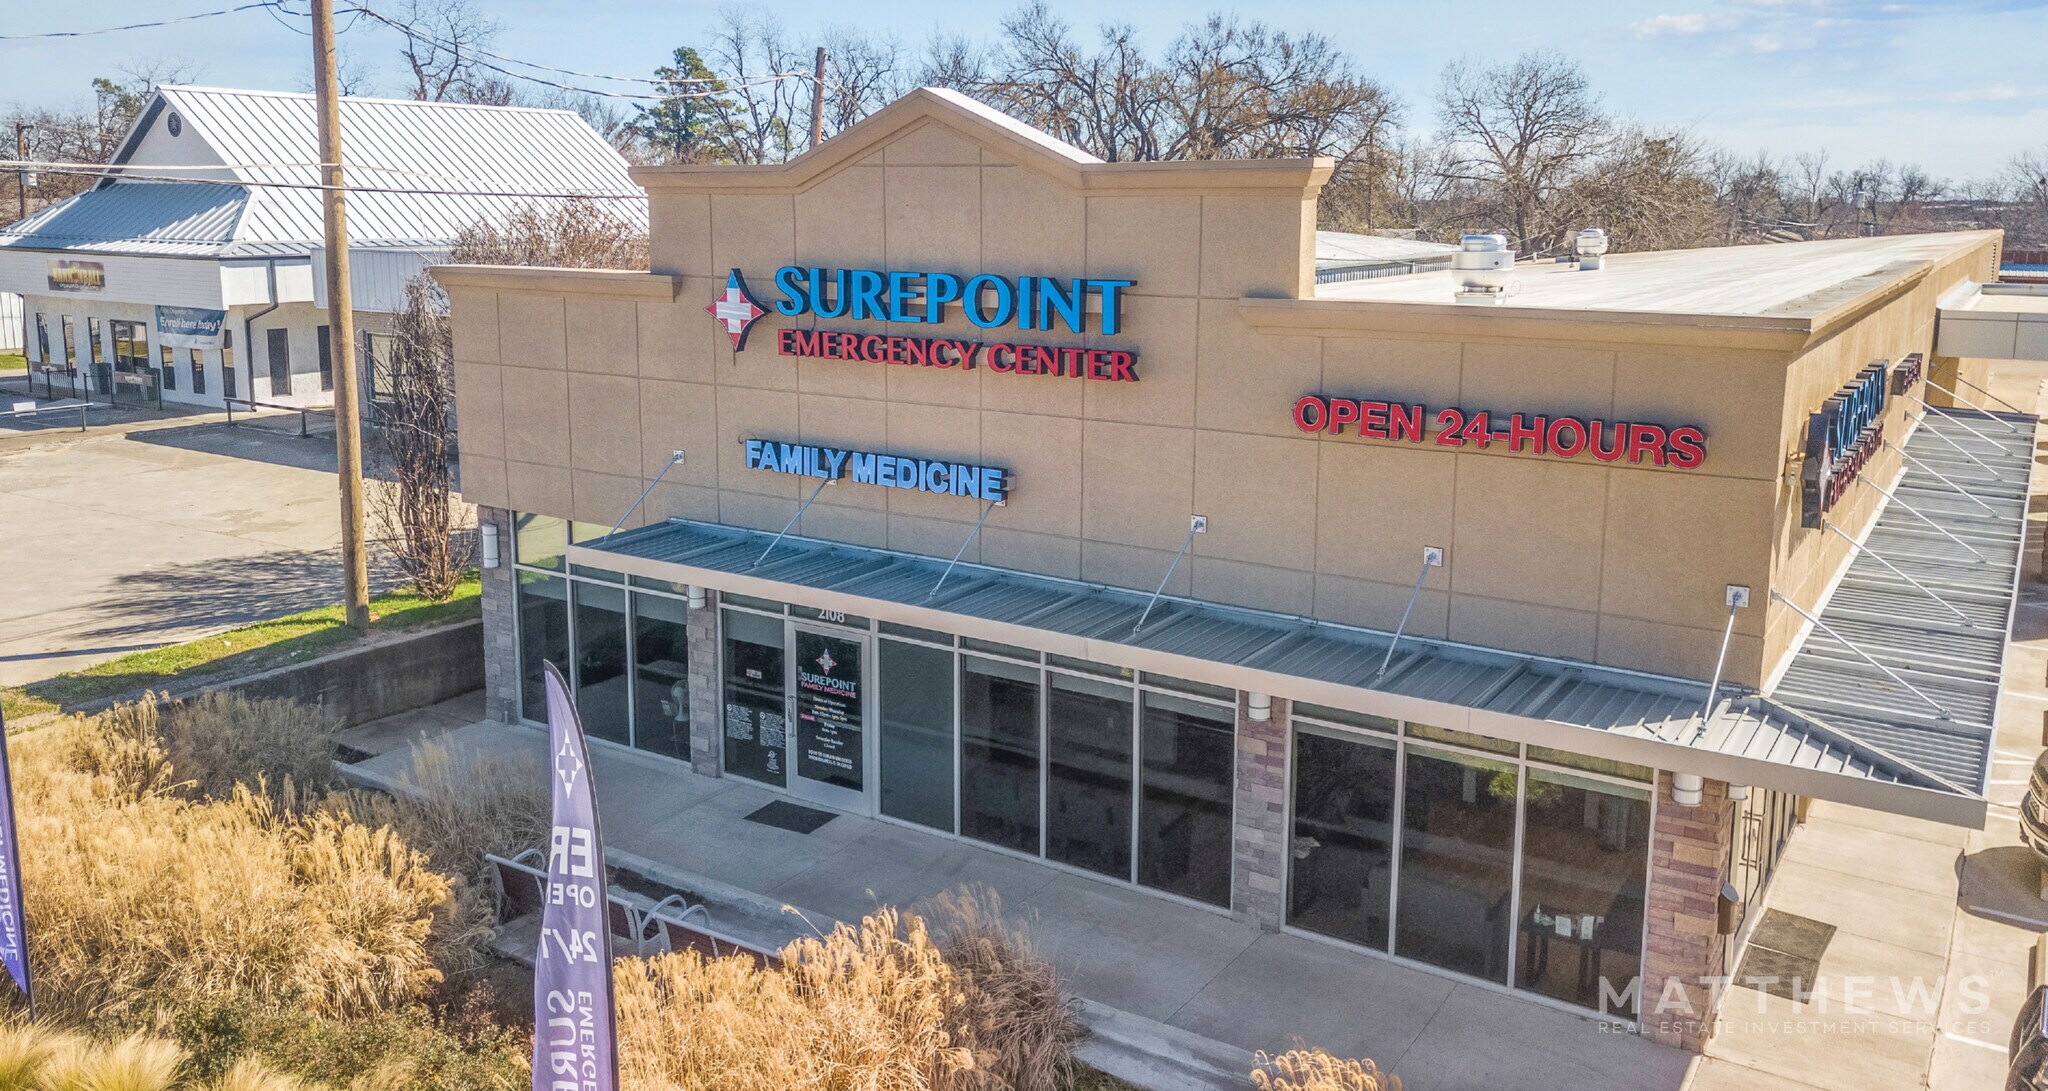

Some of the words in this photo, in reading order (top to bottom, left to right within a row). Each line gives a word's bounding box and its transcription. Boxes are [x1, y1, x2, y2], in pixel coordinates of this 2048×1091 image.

[775, 266, 1136, 335] SUREPOINT
[160, 316, 180, 328] Enroll
[181, 318, 197, 329] here
[778, 329, 980, 370] EMERGENCY
[987, 342, 1140, 381] CENTER
[1294, 395, 1424, 443] OPEN
[1434, 408, 1706, 470] 24-HOURS
[745, 439, 846, 480] FAMILY
[852, 452, 1007, 501] MEDICINE
[818, 609, 845, 623] 2108
[801, 672, 856, 691] SUREPOINT
[801, 682, 824, 692] FAMILY
[824, 687, 856, 698] MEDICINE
